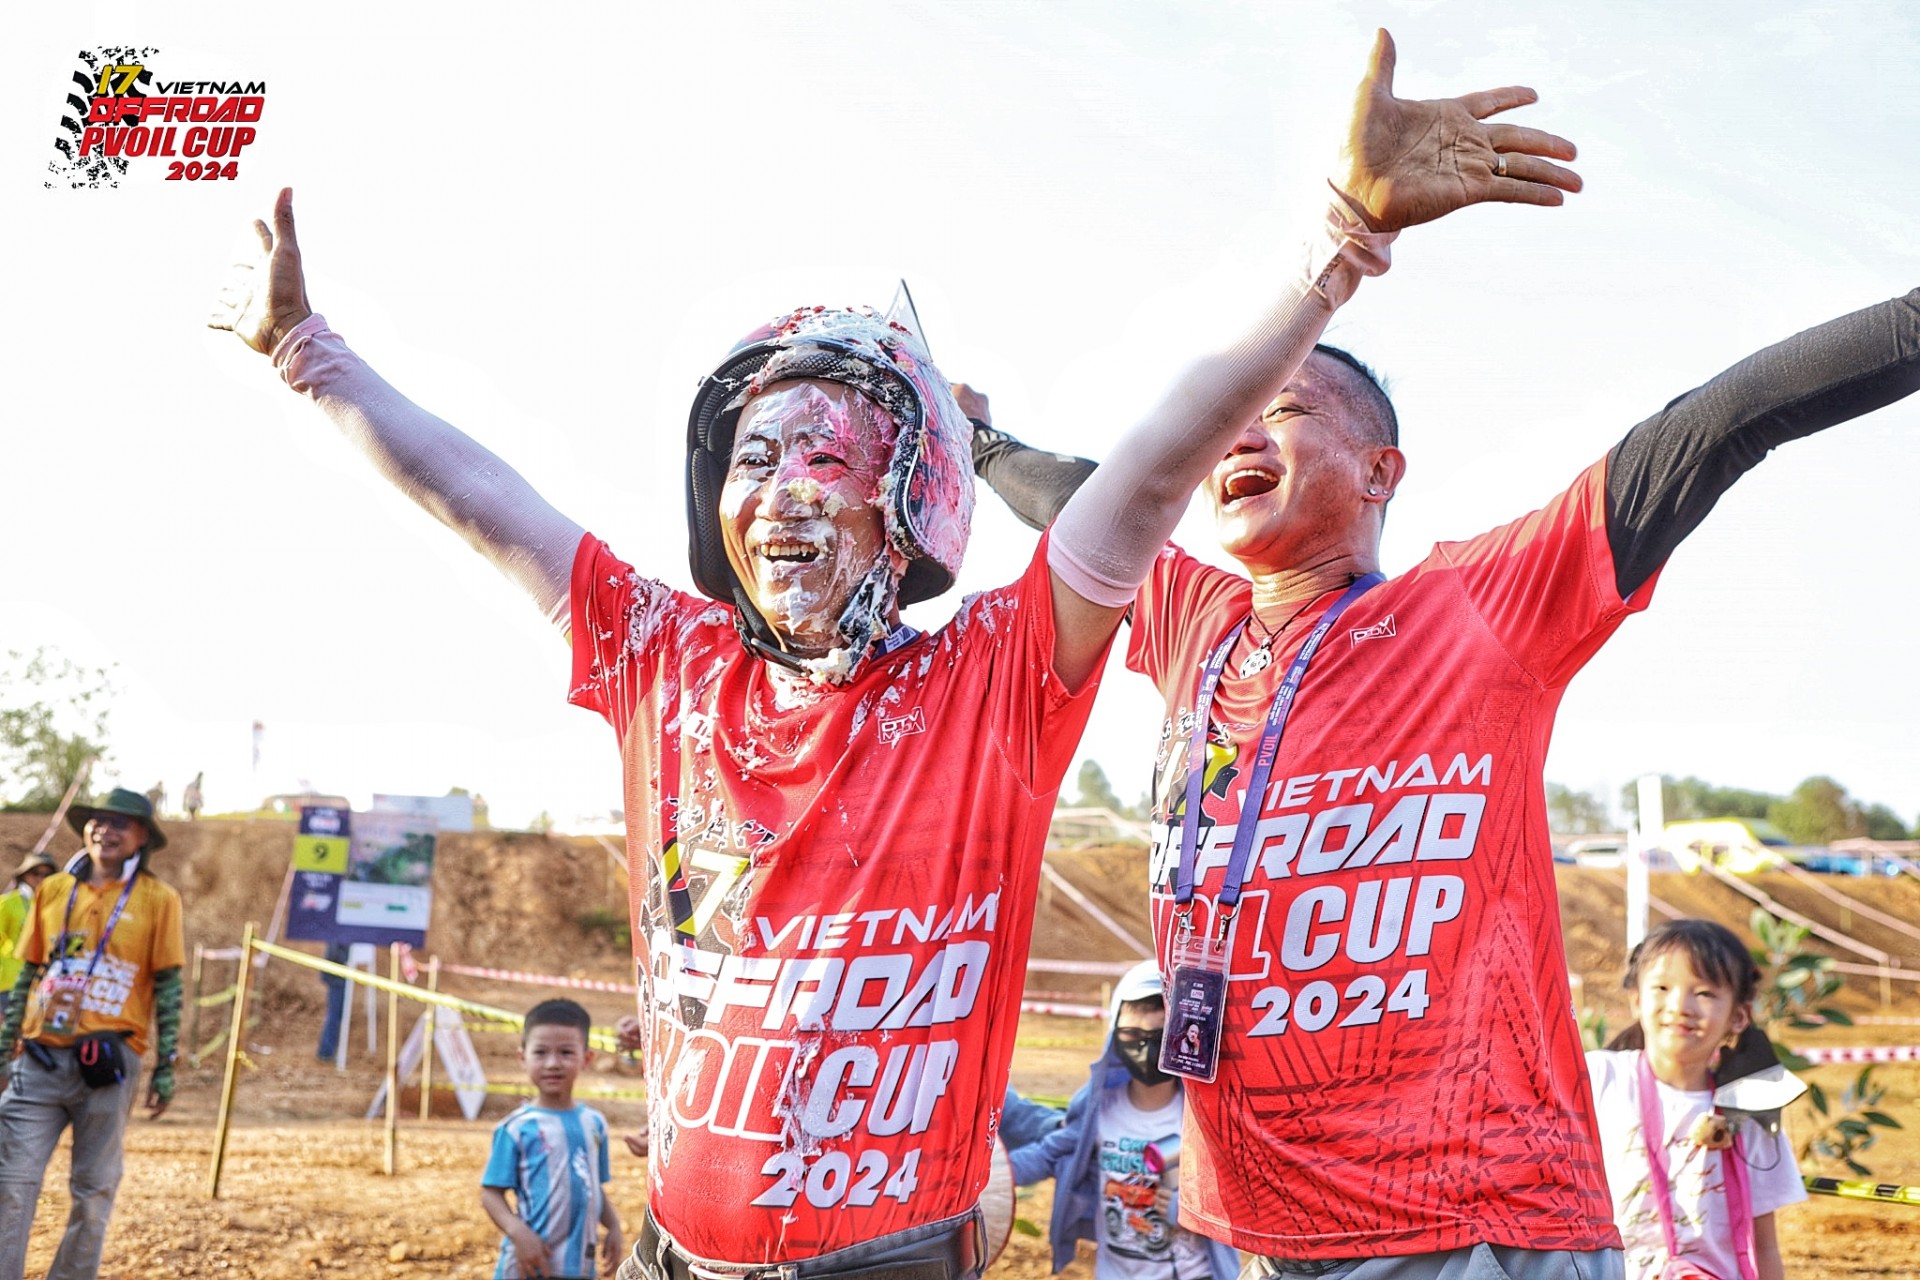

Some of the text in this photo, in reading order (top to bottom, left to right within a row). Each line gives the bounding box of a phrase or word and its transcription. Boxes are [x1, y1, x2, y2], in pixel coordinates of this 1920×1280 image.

[1258, 733, 1279, 767] PVOIL
[314, 843, 329, 863] 9
[756, 886, 999, 951] VIETNAM
[1281, 875, 1465, 972] CUP
[1246, 969, 1431, 1038] 2024
[803, 1038, 960, 1138] CUP
[750, 1148, 922, 1209] 2024
